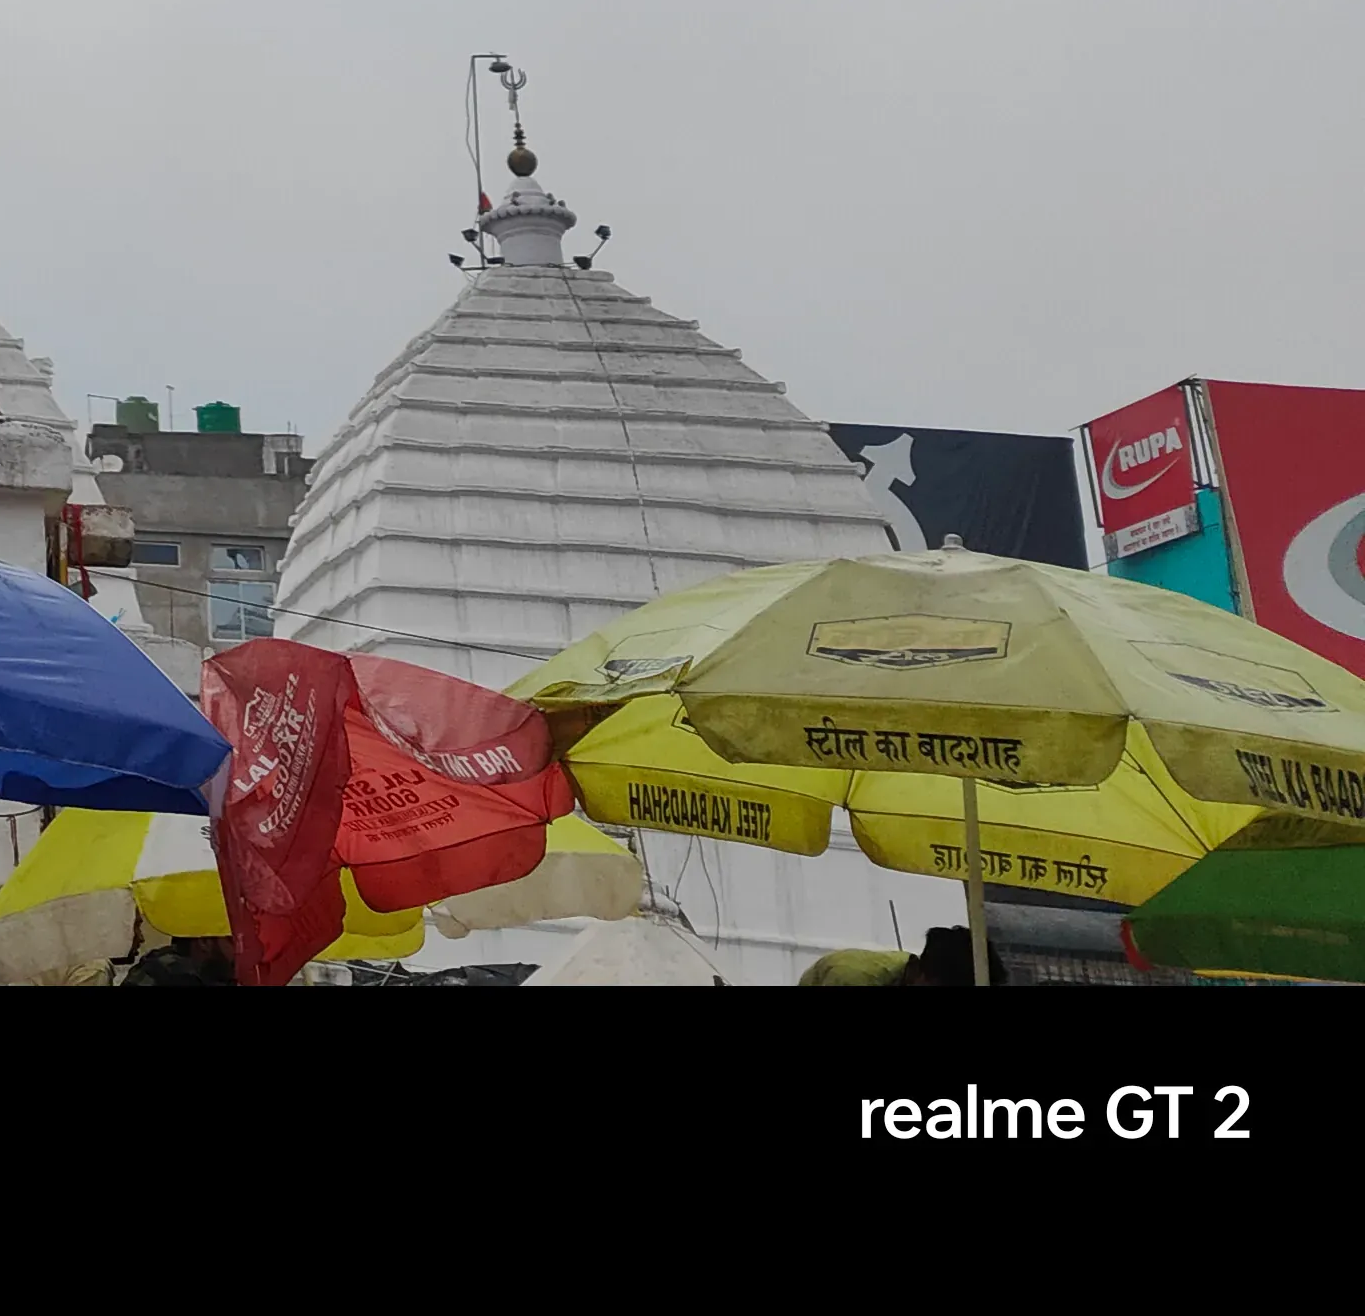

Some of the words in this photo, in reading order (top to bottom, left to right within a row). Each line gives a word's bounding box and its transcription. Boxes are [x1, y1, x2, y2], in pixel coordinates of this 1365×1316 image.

[1118, 426, 1183, 472] RUPA
[438, 752, 479, 779] TMT
[473, 745, 523, 777] BAR
[803, 715, 869, 762] स्टील
[873, 730, 911, 764] का
[916, 732, 1023, 775] बादशाह
[233, 754, 279, 793] LAL
[1281, 758, 1314, 810] KA
[1310, 763, 1365, 819] BAAD
